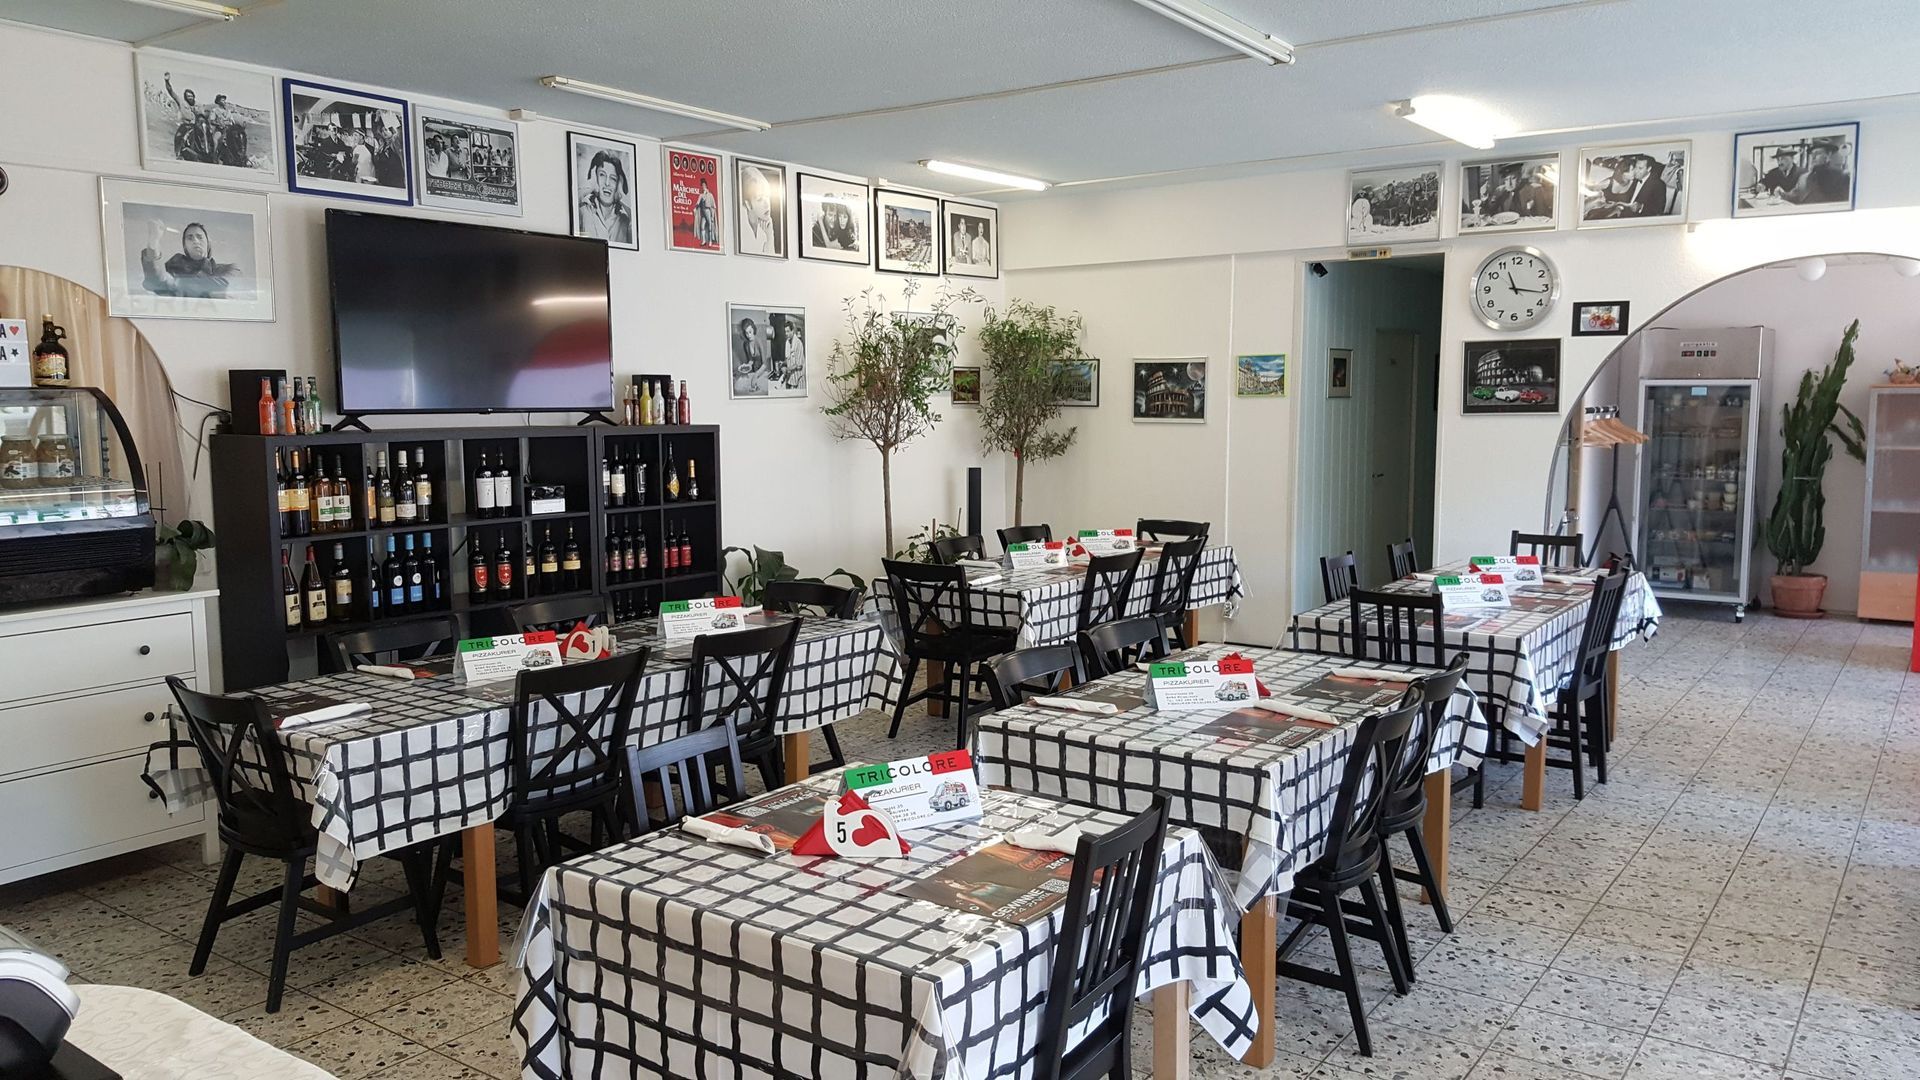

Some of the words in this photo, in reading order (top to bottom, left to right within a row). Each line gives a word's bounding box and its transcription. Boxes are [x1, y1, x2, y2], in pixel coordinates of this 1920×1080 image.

[1499, 261, 1507, 270] 11
[1511, 256, 1523, 266] 12
[1529, 259, 1533, 268] 1
[1488, 271, 1500, 280] 10
[1538, 269, 1546, 279] 2
[1483, 285, 1491, 295] 9
[1542, 283, 1549, 293] 3
[1487, 299, 1495, 308] 8
[1536, 298, 1543, 307] 4
[1497, 309, 1504, 319] 7
[1510, 312, 1518, 322] 6
[1526, 308, 1533, 317] 5
[1066, 547, 1070, 556] 2
[1442, 577, 1494, 585] TRICOLORE
[668, 600, 731, 610] TRICOLORE
[468, 635, 544, 649] TRICOLORE
[592, 639, 596, 653] 1
[472, 649, 516, 658] PIZZAKURIER
[1159, 664, 1241, 675] TRICOLORE
[857, 757, 957, 784] TRICOLORE
[837, 821, 846, 844] 5
[1045, 857, 1070, 870] zero
[992, 888, 1045, 917] GEWINNE
